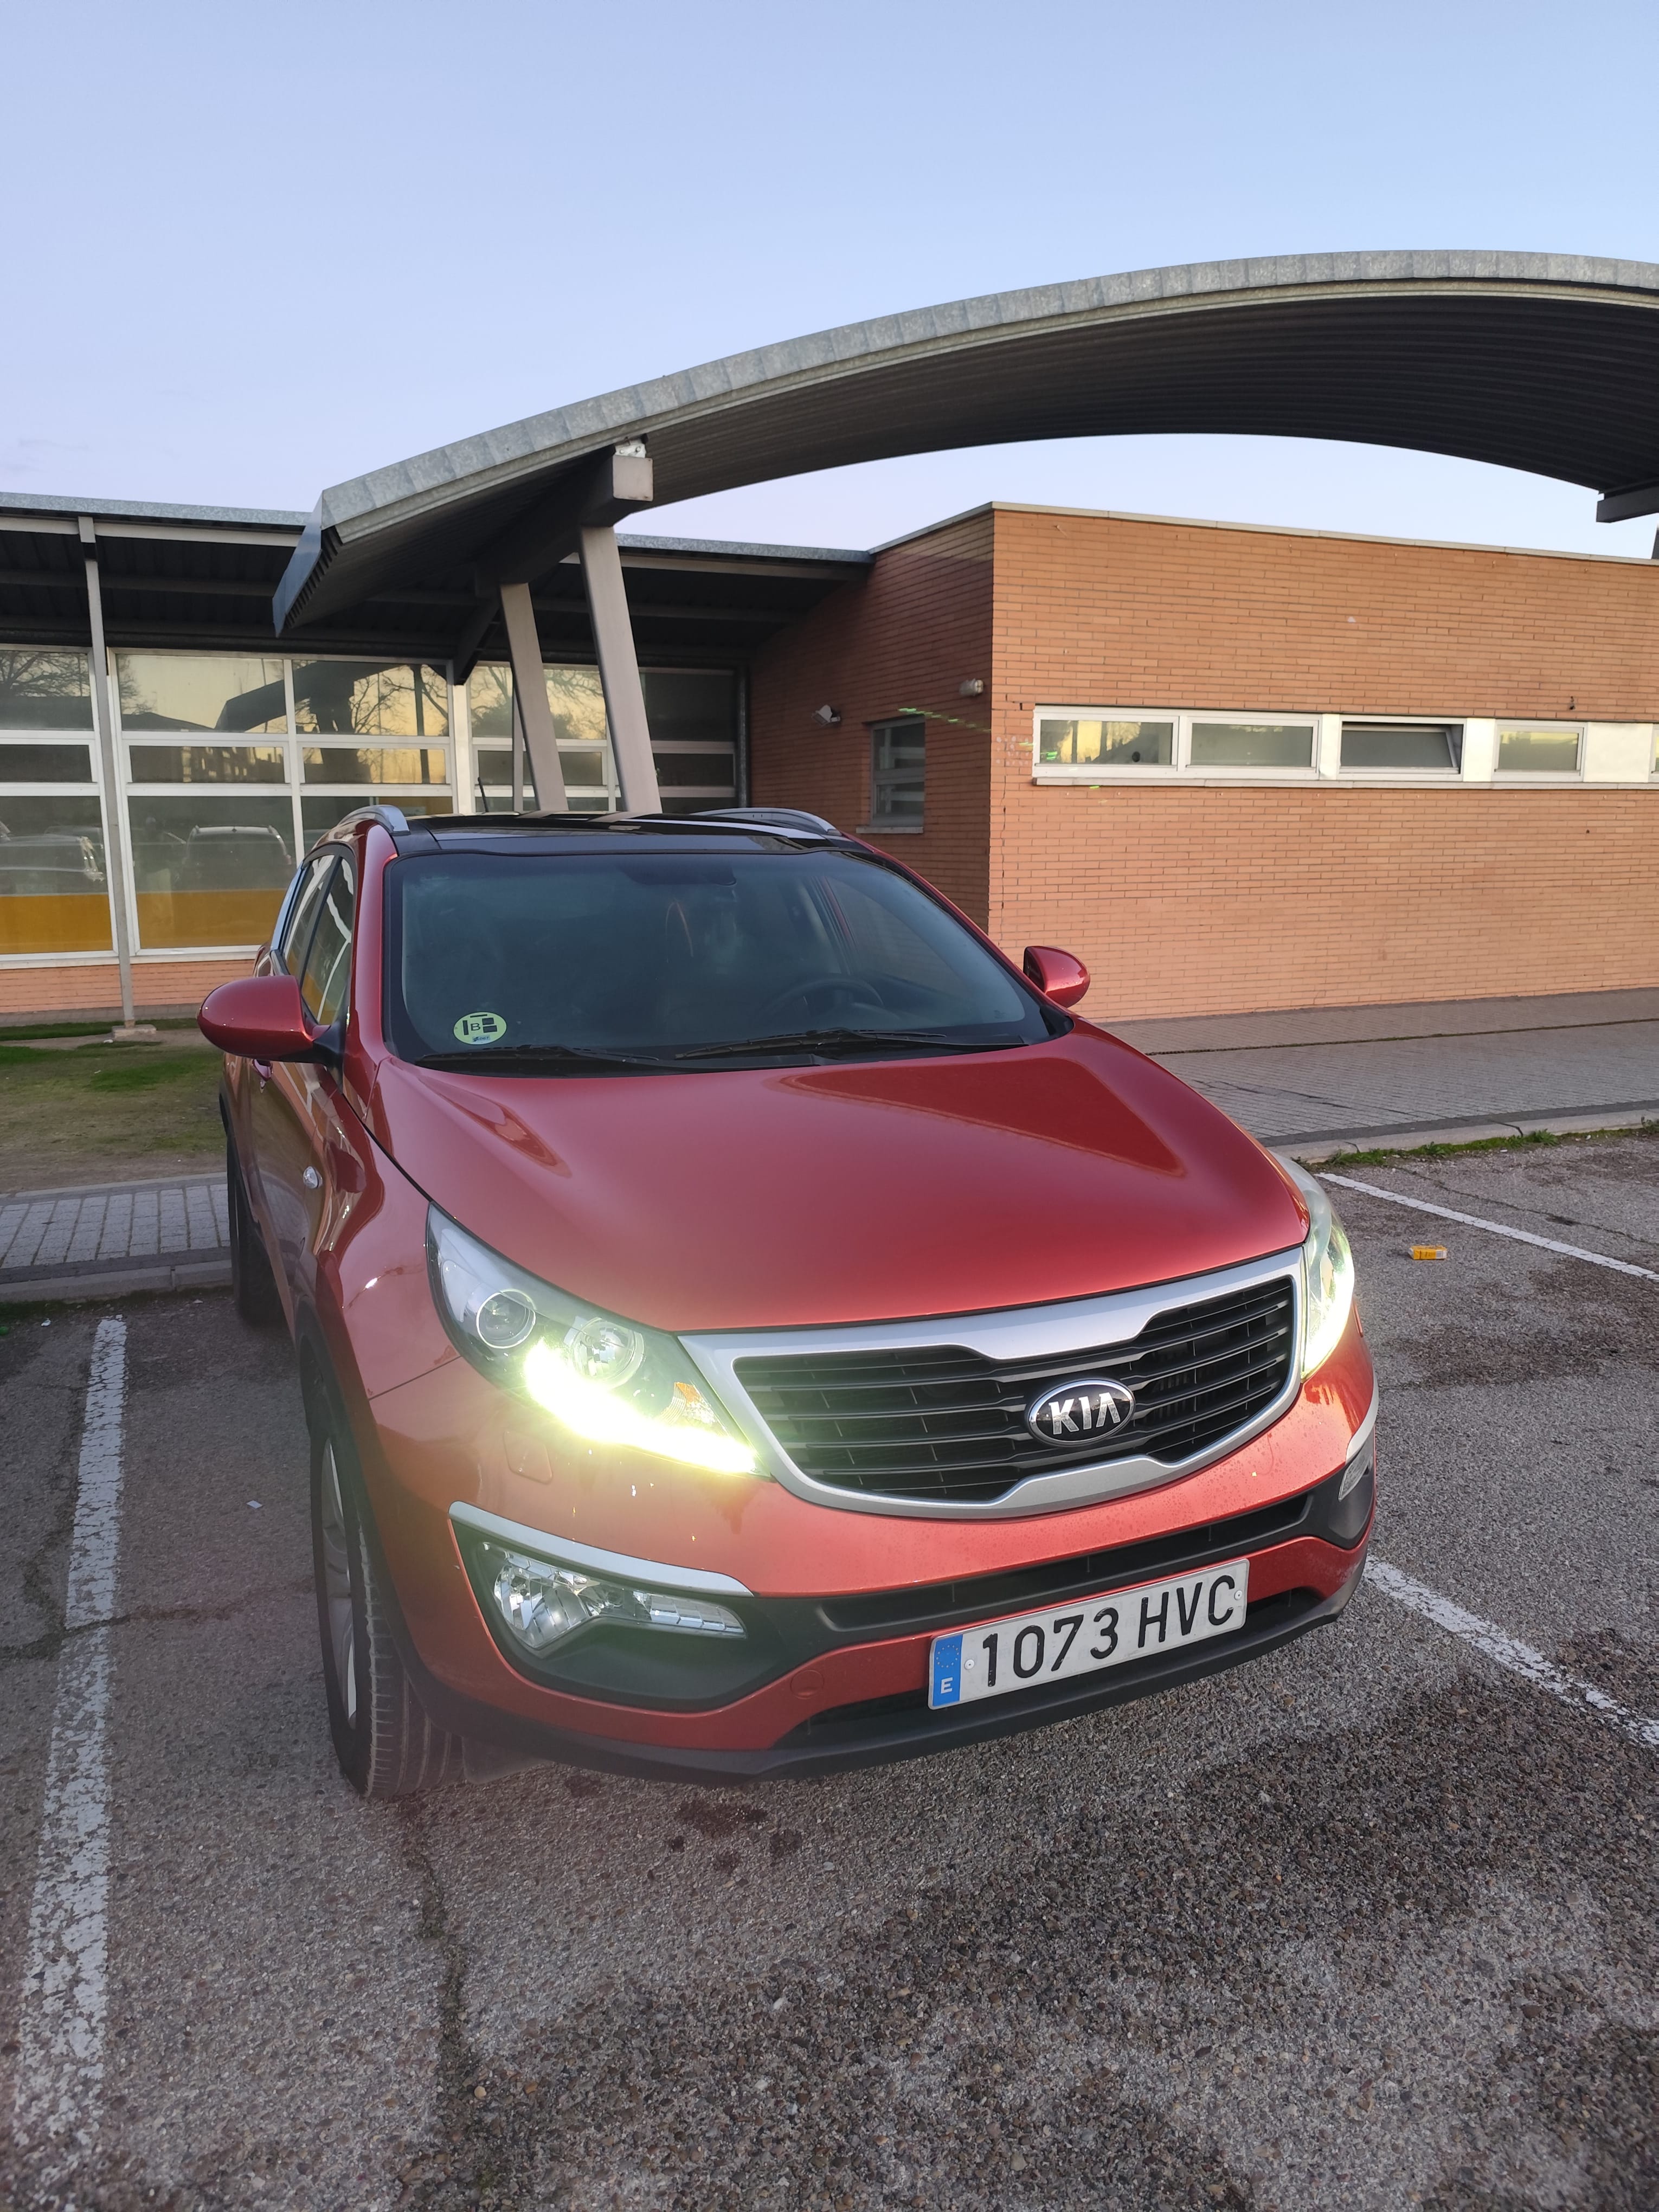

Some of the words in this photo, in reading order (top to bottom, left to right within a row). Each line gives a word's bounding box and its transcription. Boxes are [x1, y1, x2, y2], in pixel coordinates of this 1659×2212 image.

[471, 1023, 481, 1031] B
[1049, 1392, 1121, 1435] KIA
[982, 1607, 1119, 1687] 1073
[1138, 1575, 1235, 1648] HVC
[941, 1677, 953, 1694] E
